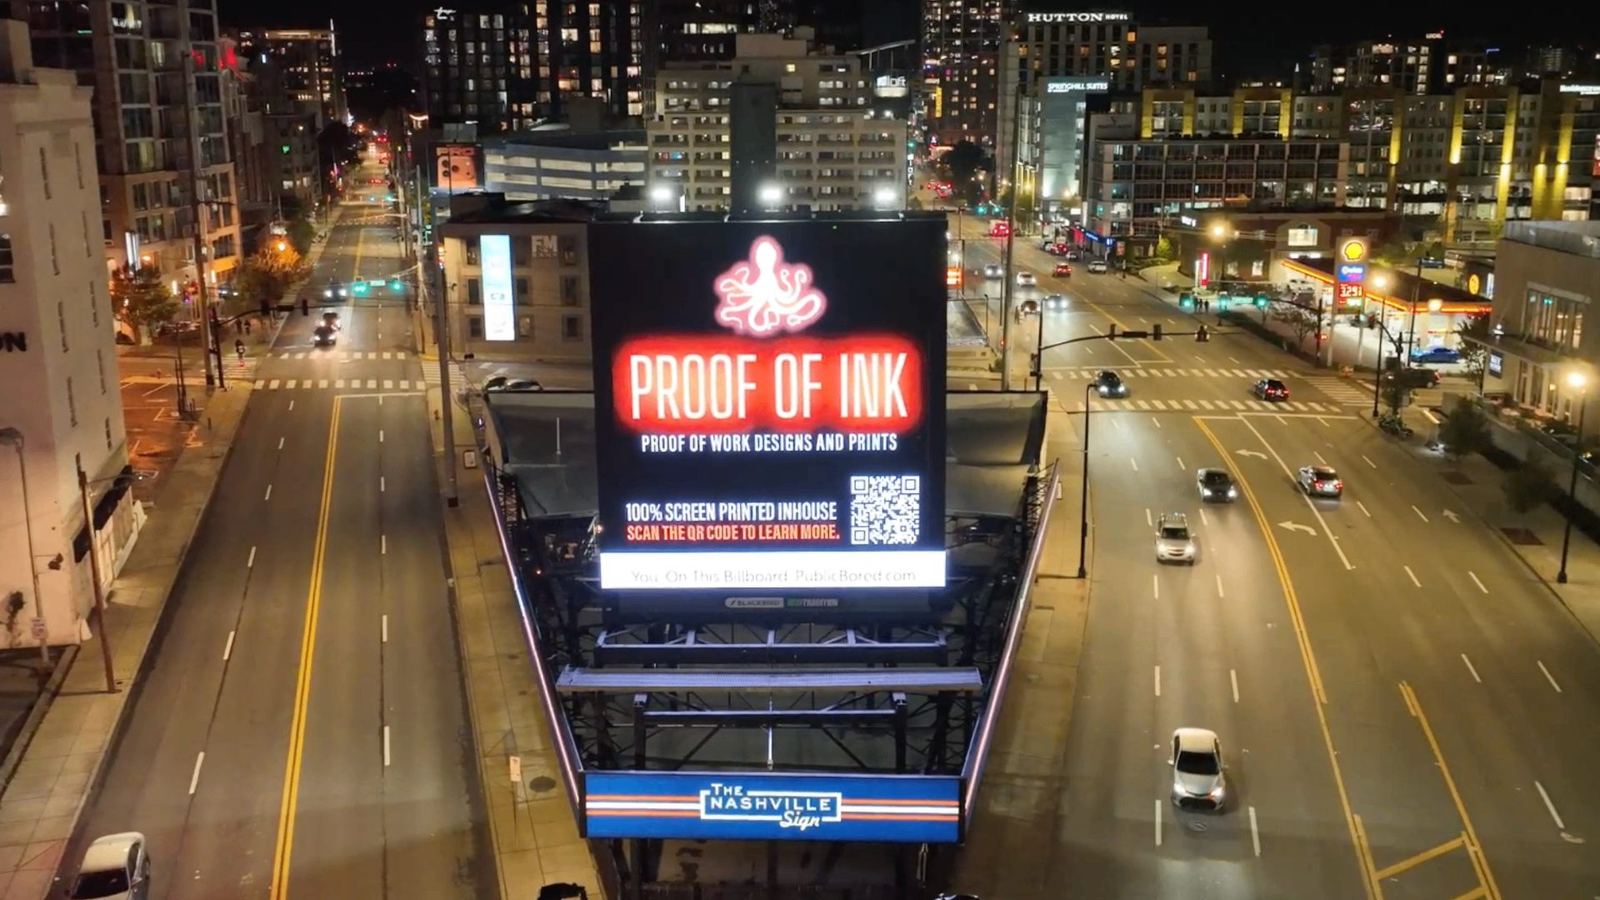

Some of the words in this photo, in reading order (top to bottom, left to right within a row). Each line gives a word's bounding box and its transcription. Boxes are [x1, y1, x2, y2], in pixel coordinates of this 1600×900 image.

[1028, 12, 1104, 22] HUTTON
[630, 354, 757, 420] PROOF
[774, 353, 823, 419] OF
[840, 352, 908, 418] INK
[641, 434, 685, 452] PROOF
[689, 434, 706, 452] OF
[710, 434, 750, 452] WORK
[754, 434, 812, 452] DESIGNS
[815, 434, 844, 451] AND
[849, 433, 898, 451] PRINTS
[625, 502, 663, 522] 100%
[664, 502, 716, 522] SCREEN
[719, 502, 775, 521] PRINTED
[778, 501, 838, 521] INHOUSE
[627, 524, 660, 541] SCAN
[662, 524, 685, 541] THE
[687, 524, 704, 541] QR
[706, 524, 739, 541] CODE
[740, 524, 756, 541] TO
[759, 524, 799, 541] LEARN
[800, 524, 840, 541] MORE.
[665, 570, 687, 583] On
[693, 570, 720, 583] This
[724, 570, 788, 583] Billboard
[711, 783, 743, 796] THE
[710, 796, 832, 811] NASHVILLE
[779, 810, 820, 831] Sign
